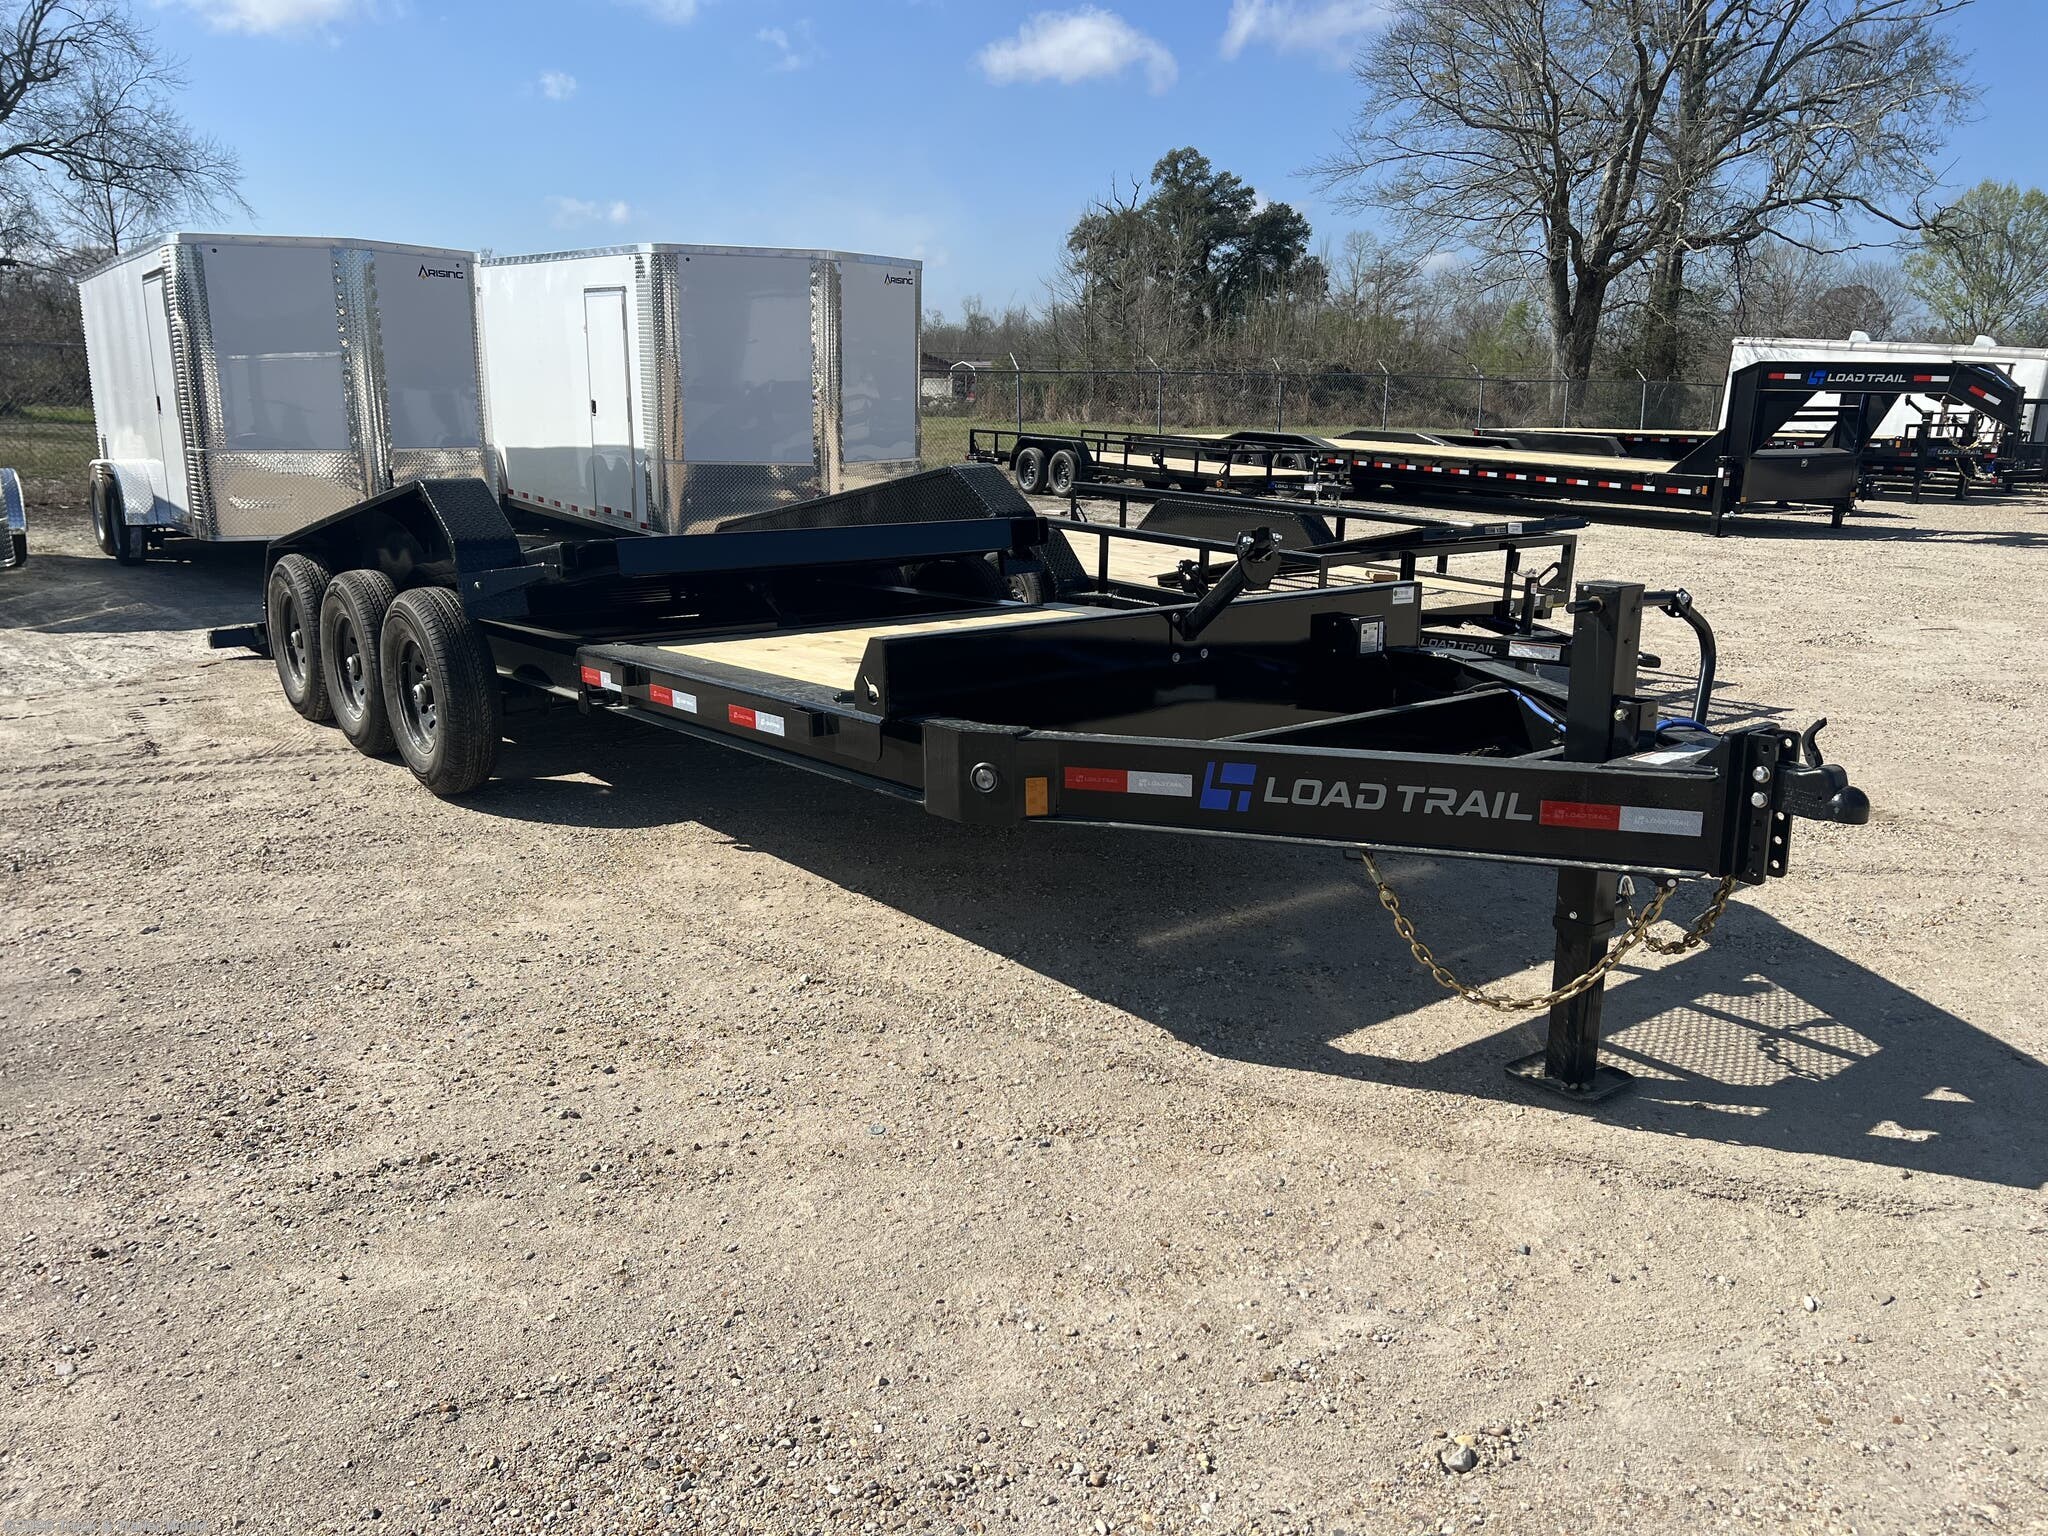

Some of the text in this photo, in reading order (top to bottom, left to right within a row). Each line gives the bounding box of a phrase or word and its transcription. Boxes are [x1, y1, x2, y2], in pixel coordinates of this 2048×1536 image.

[1827, 373, 1865, 382] LOAD
[1867, 374, 1907, 383] TRAIL
[1420, 638, 1458, 649] LOAD
[1459, 642, 1497, 655] TRAIL
[1263, 777, 1388, 811] LOAD
[1397, 785, 1533, 822] TRAIL
